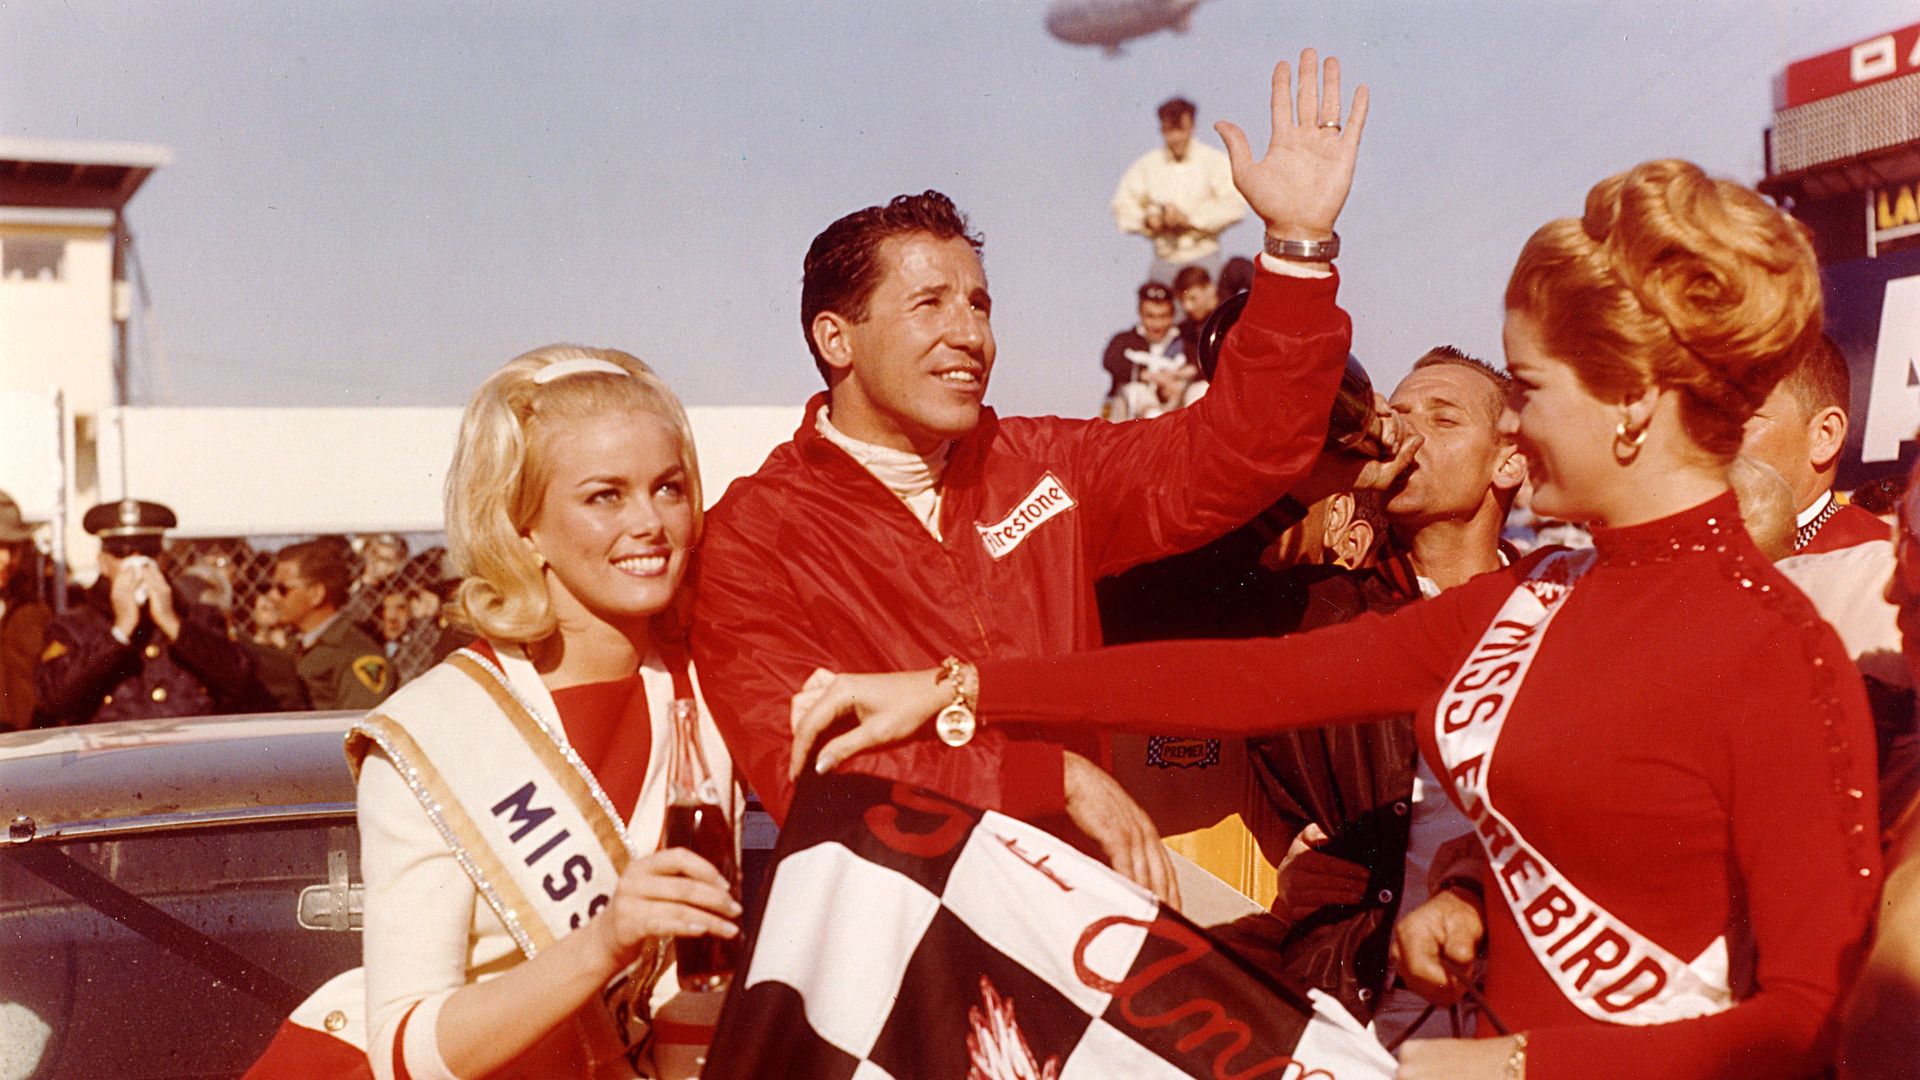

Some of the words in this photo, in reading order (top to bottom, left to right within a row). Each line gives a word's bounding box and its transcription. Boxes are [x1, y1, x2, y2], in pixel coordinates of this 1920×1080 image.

[1878, 184, 1920, 229] LA
[982, 487, 1063, 553] Firestone
[1444, 620, 1535, 735] MISS
[1163, 744, 1204, 758] PREMIER
[1451, 752, 1667, 1012] FIREBIRD
